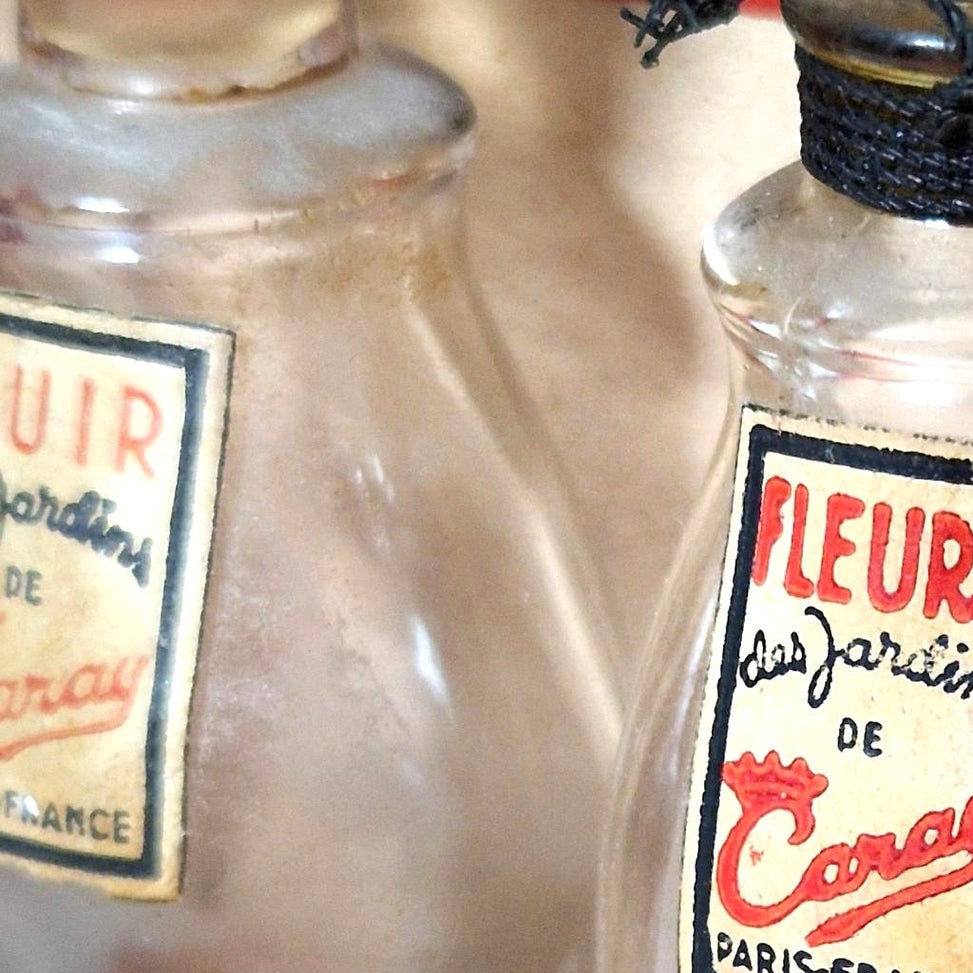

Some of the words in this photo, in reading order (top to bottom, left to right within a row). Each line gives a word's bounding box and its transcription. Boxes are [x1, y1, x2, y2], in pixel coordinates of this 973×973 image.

[8, 363, 164, 479] UIR
[0, 471, 153, 588] ardins
[6, 565, 43, 605] DE
[740, 630, 806, 687] des
[837, 717, 883, 757] DE
